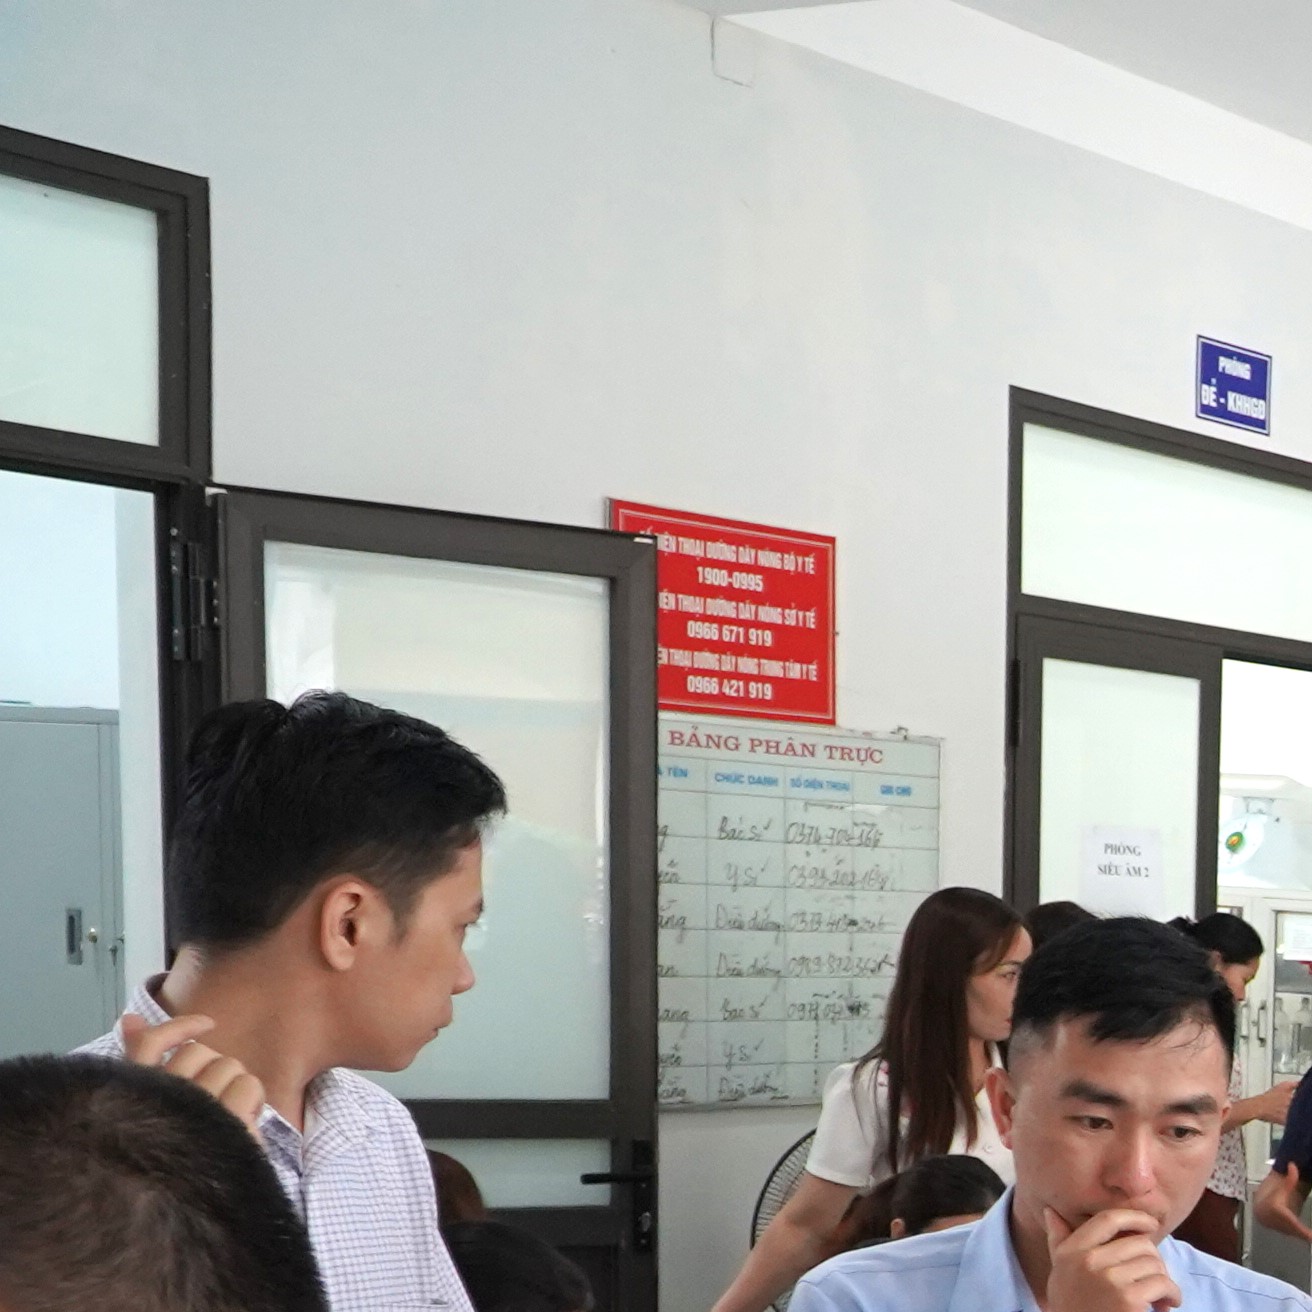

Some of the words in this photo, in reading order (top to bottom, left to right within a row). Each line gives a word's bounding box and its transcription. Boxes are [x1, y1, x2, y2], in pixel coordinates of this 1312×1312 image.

[697, 566, 763, 592] 1900-0995
[687, 620, 719, 641] 0966
[722, 626, 745, 645] 671
[749, 629, 773, 647] 919
[687, 675, 719, 696] 0966
[722, 680, 745, 697] 421
[749, 683, 773, 700] 919
[668, 726, 741, 751] BẢNG
[749, 736, 816, 758] PHÂN
[823, 744, 884, 766] TRỰC
[1104, 841, 1142, 856] PHÒNG
[1125, 863, 1142, 877] ÂM
